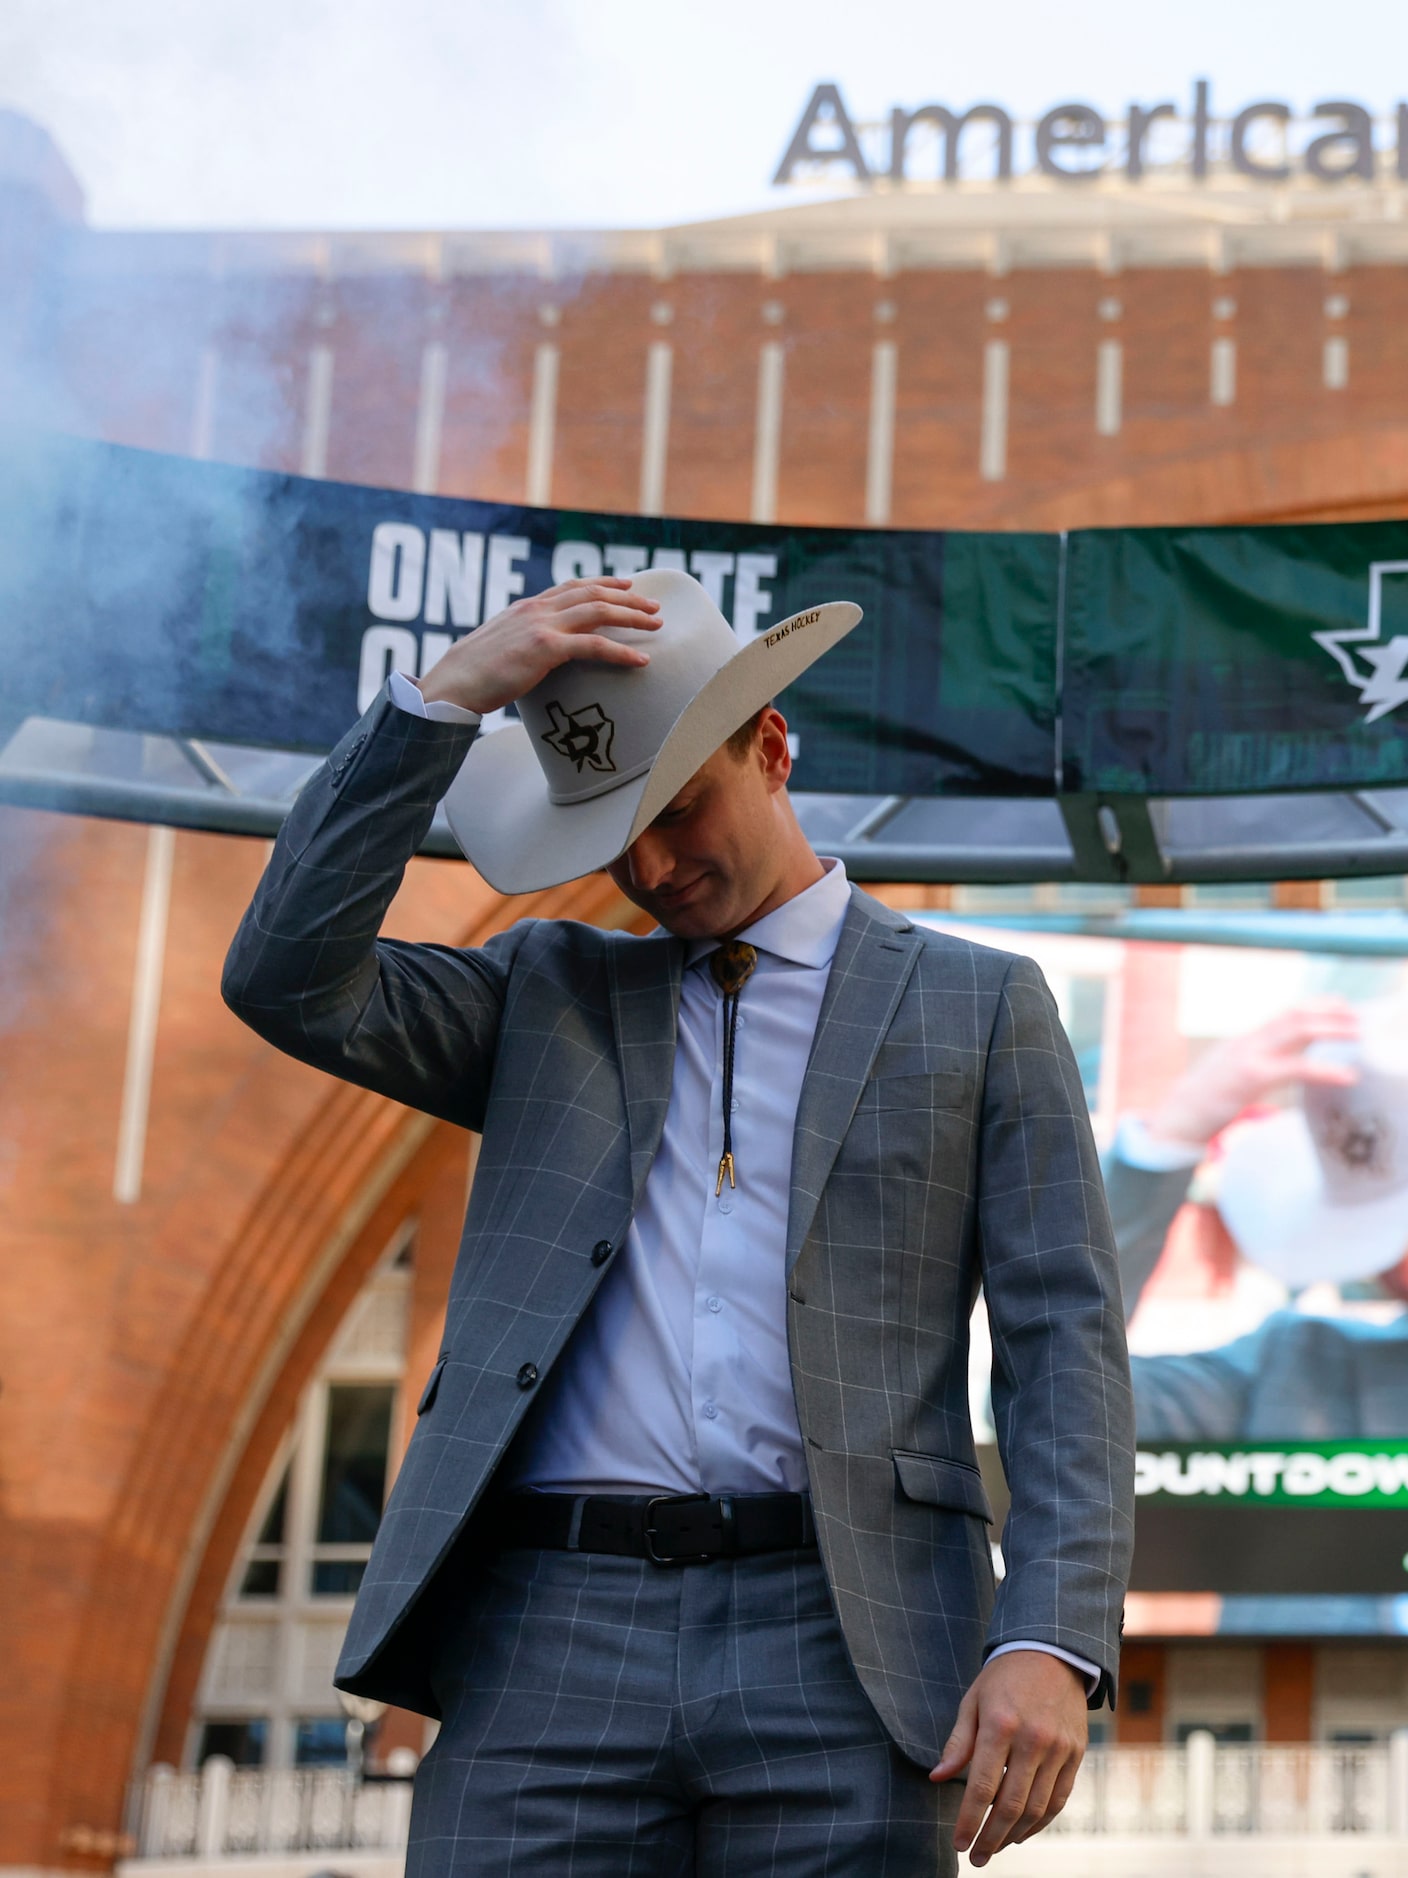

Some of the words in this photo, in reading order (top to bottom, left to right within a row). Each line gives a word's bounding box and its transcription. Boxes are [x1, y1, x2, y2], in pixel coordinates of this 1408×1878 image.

[368, 521, 531, 628] ONE
[764, 626, 790, 648] TEXAS
[791, 611, 821, 632] HOCKEY
